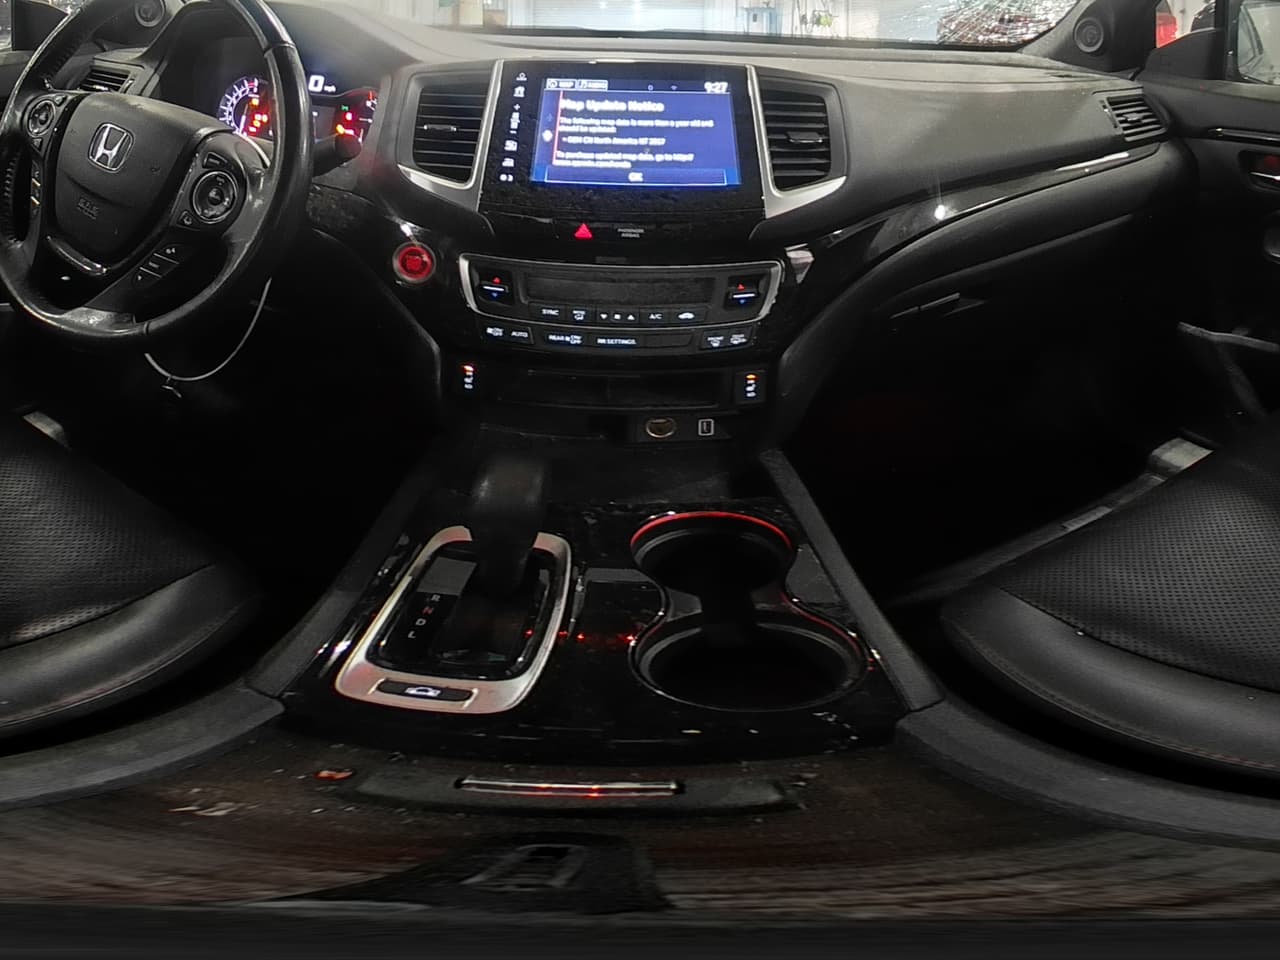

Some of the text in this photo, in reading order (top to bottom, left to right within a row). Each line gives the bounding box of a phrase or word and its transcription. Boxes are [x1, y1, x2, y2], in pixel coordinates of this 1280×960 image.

[308, 75, 325, 92] 0
[585, 99, 627, 112] Update
[627, 100, 665, 112] Notice
